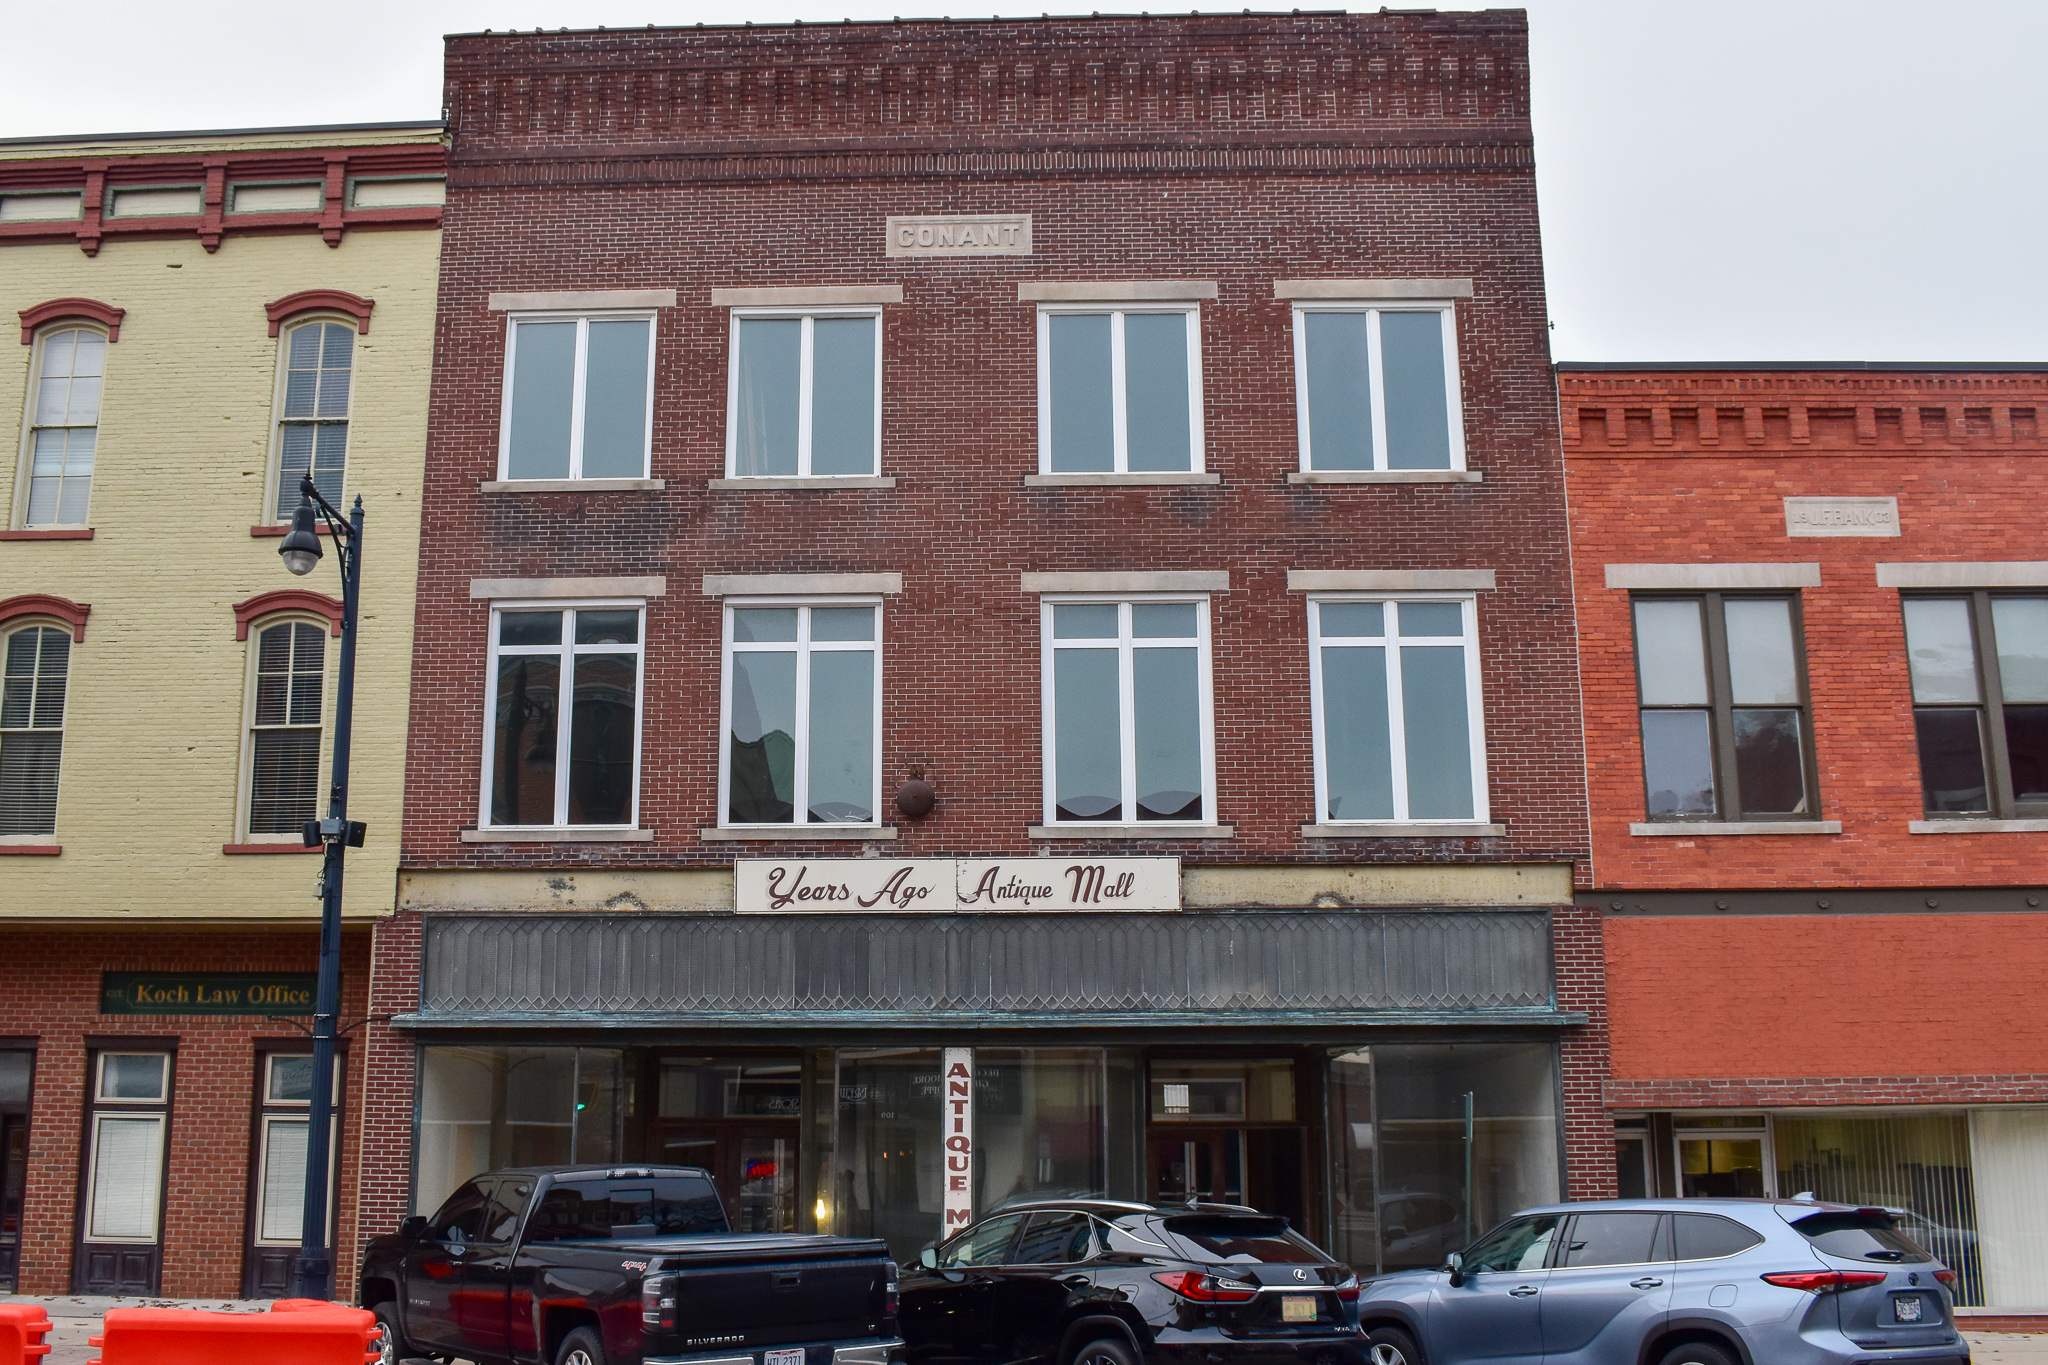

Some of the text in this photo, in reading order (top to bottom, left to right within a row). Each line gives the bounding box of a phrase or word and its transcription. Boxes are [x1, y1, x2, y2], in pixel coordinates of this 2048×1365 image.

[898, 223, 1020, 248] CONANT
[767, 865, 1136, 911] Years Ago Antique Mall
[137, 984, 310, 1004] Koch Law Office
[945, 1062, 972, 1191] ANTIQUE
[686, 1335, 745, 1346] SILVERADO
